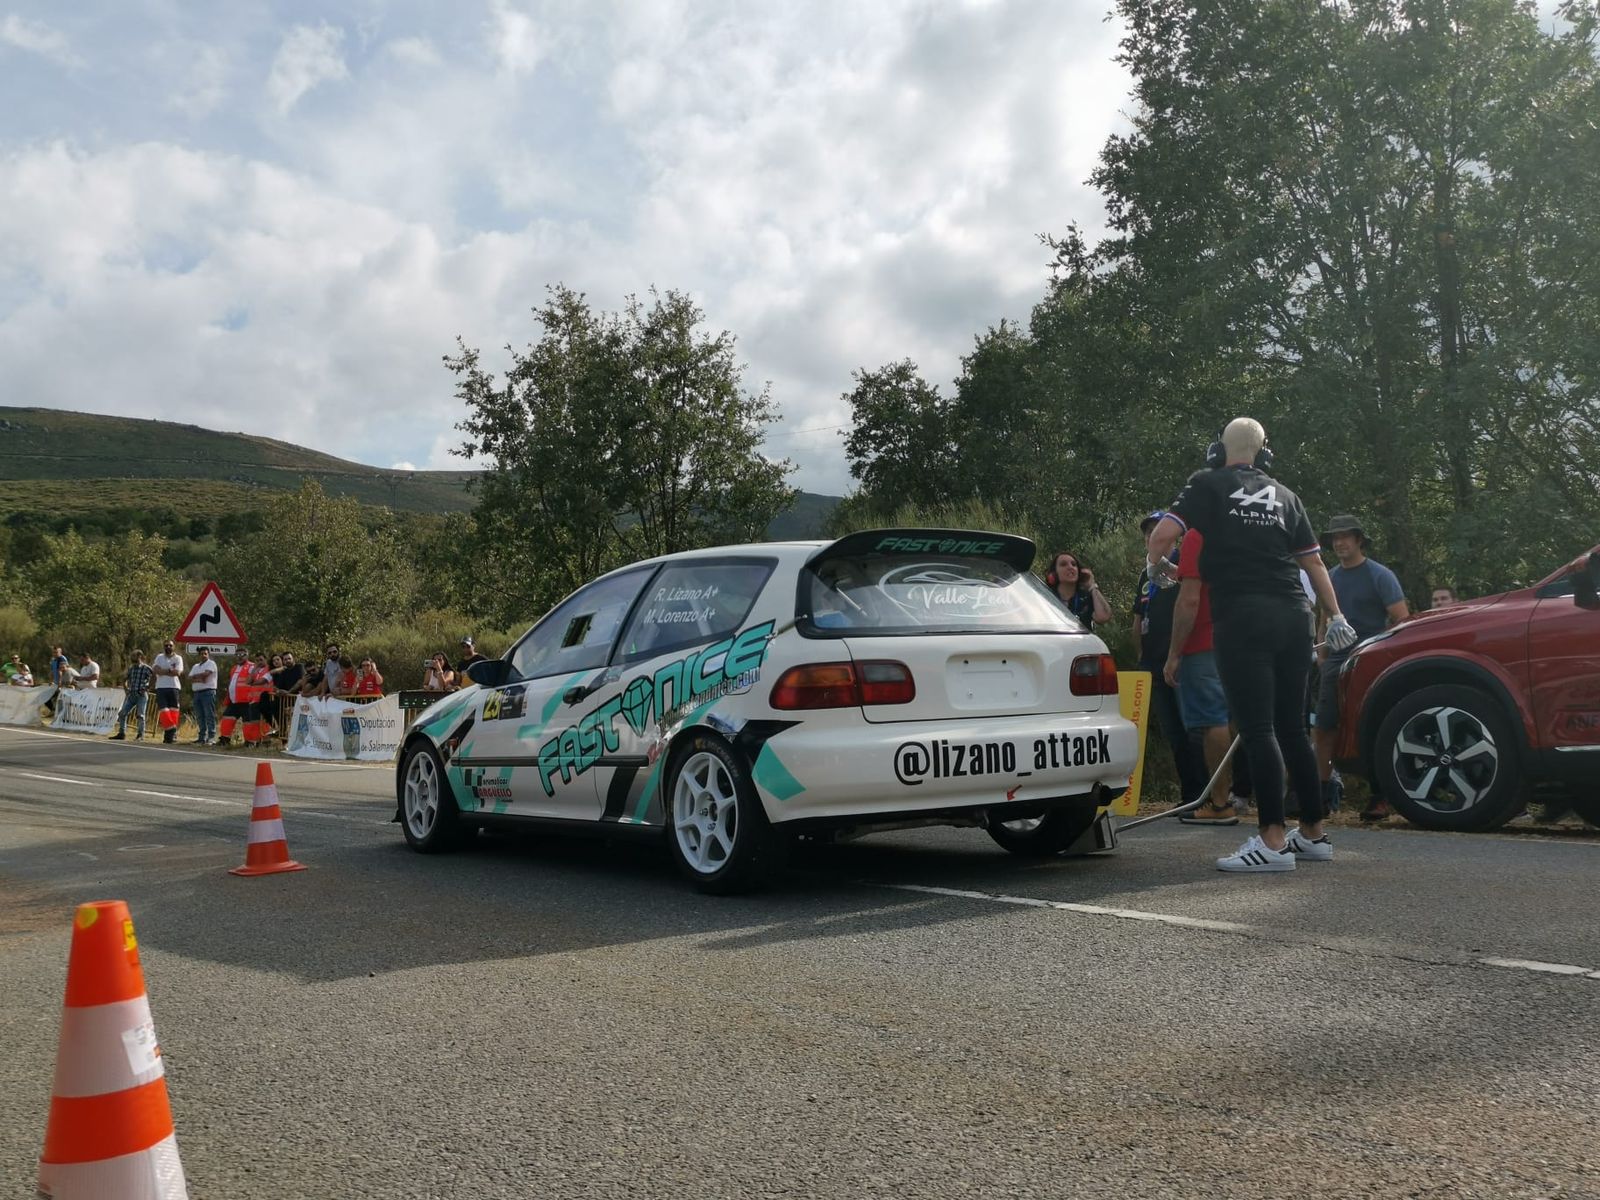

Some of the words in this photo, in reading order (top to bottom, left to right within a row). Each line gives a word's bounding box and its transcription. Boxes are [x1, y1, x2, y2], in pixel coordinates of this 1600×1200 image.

[667, 586, 702, 601] Lizano
[907, 585, 968, 609] Valle
[643, 609, 656, 624] M.
[657, 609, 700, 624] Lorenzo
[368, 740, 399, 753] Salaman
[894, 728, 1111, 786] @lizano_attack
